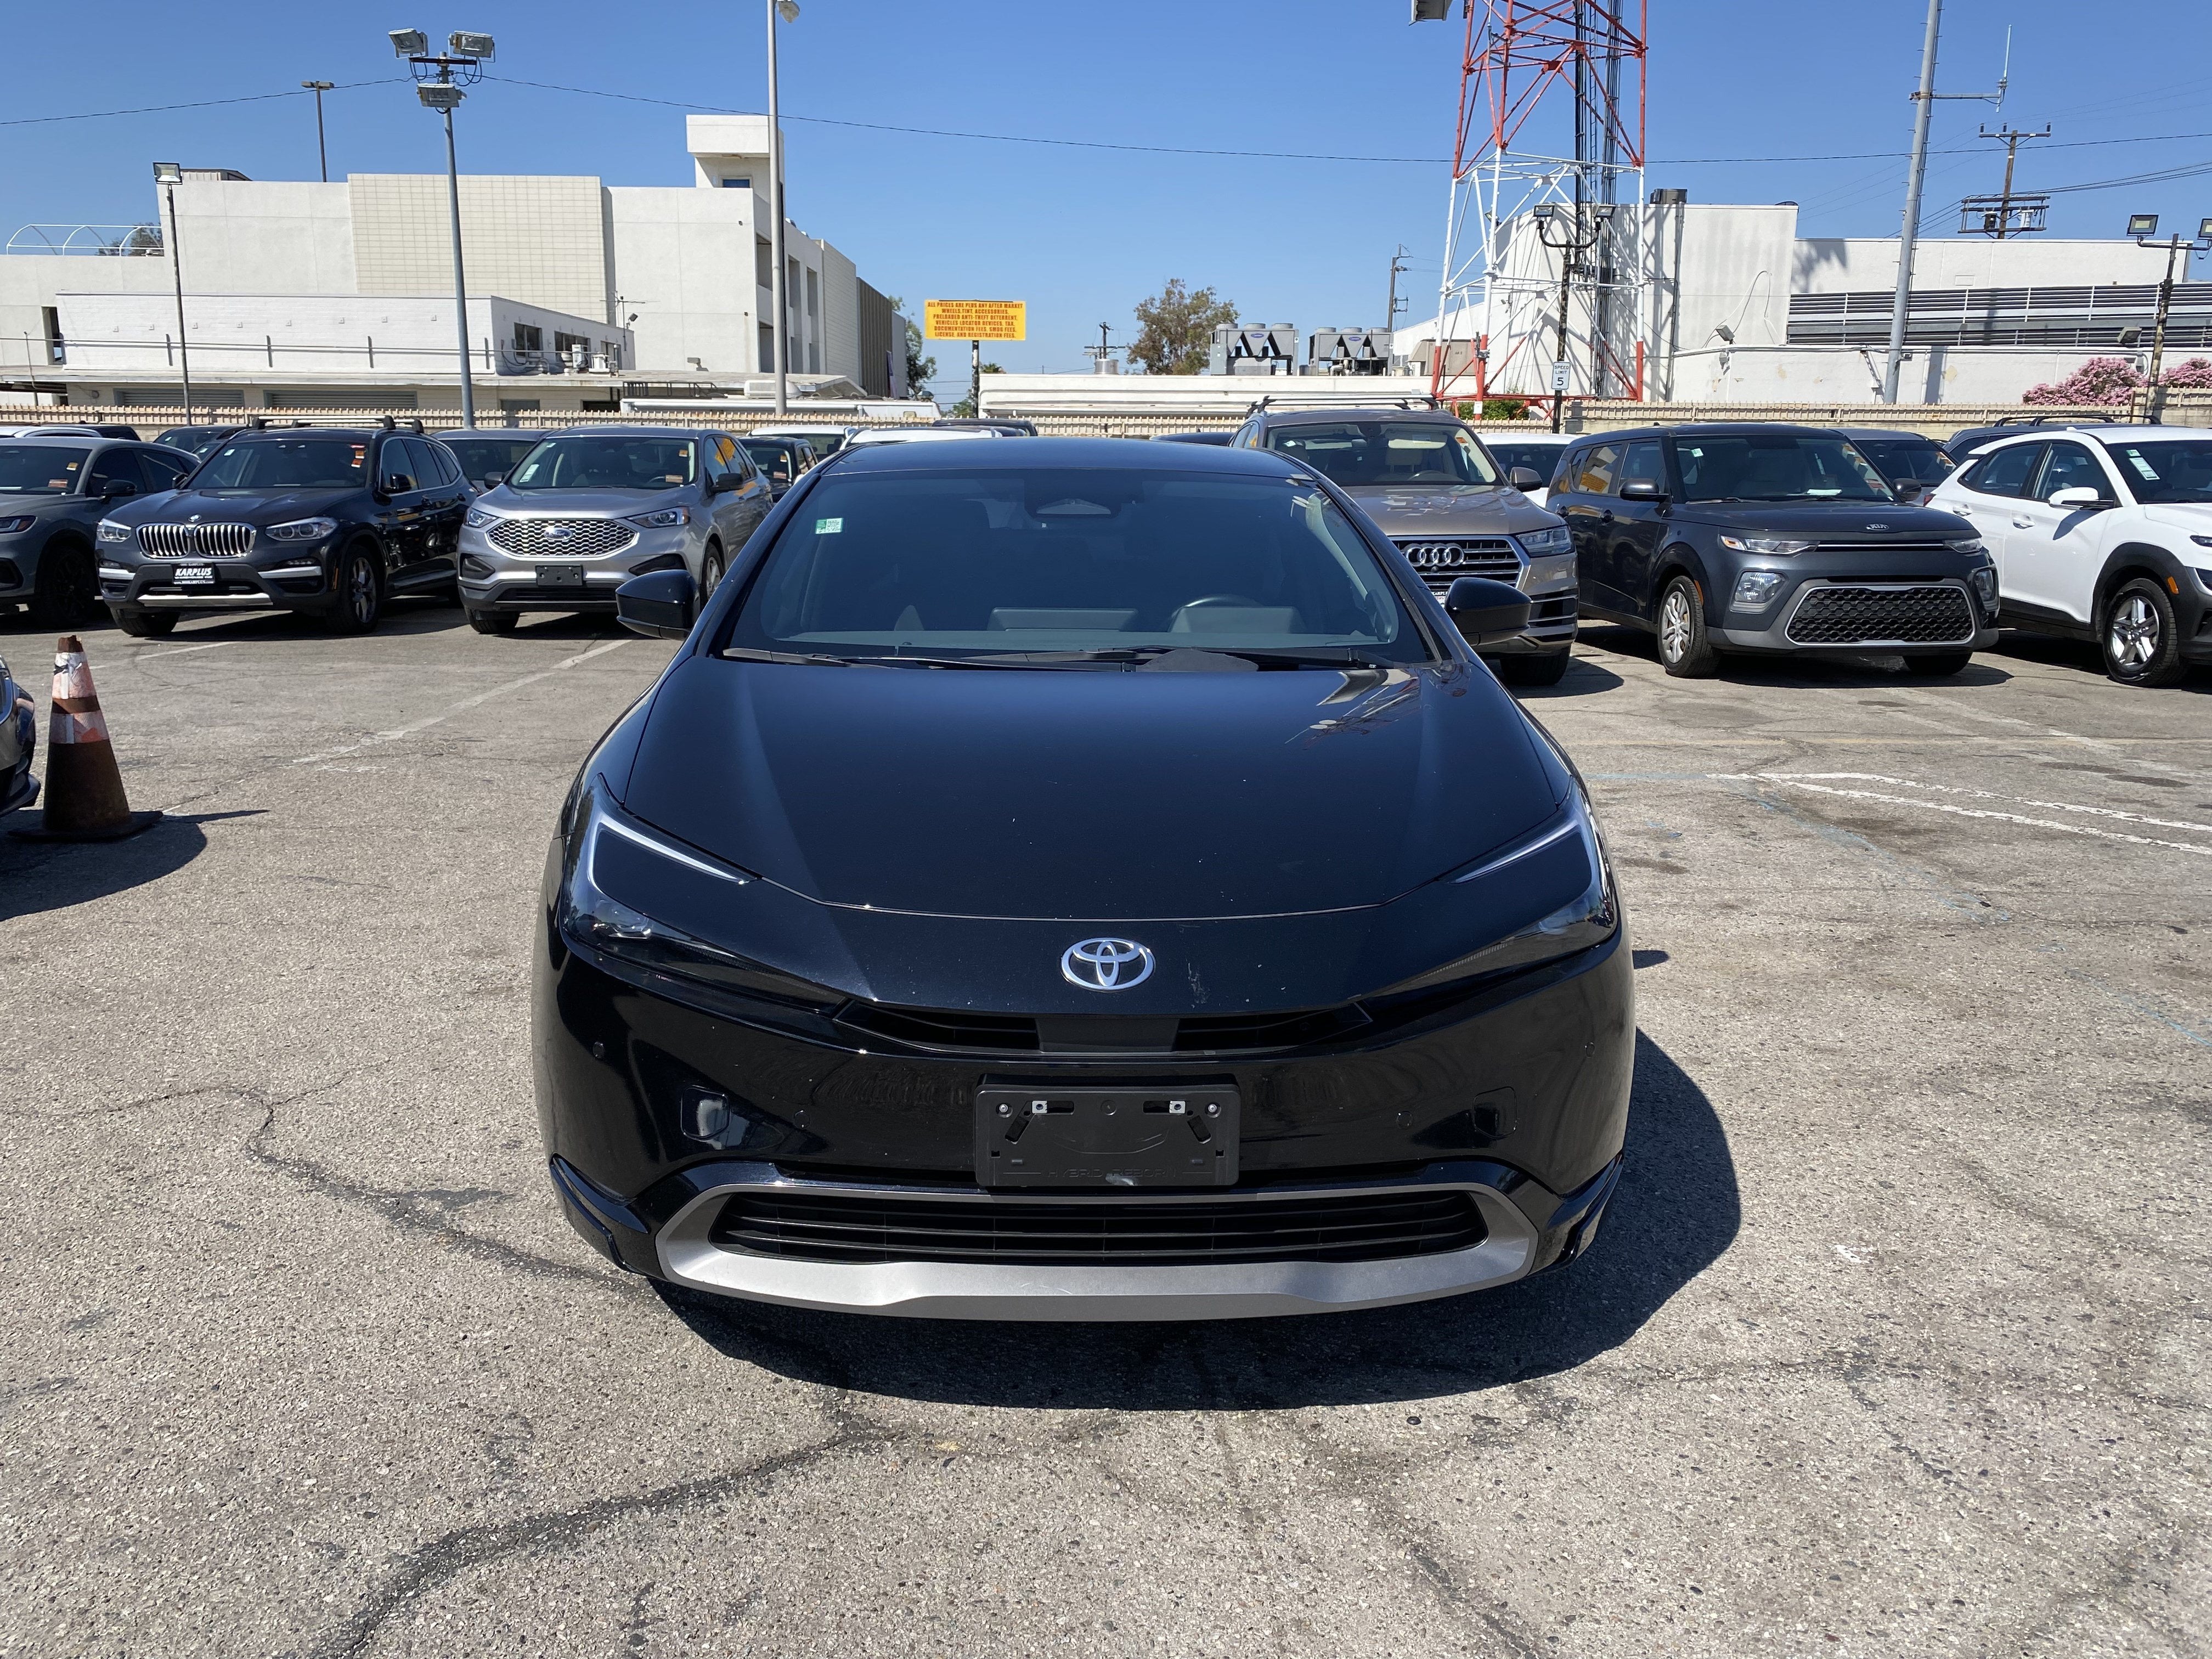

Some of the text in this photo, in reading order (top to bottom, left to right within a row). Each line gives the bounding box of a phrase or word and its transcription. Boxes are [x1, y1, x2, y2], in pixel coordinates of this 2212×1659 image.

[1557, 377, 1564, 386] 5
[175, 568, 212, 576] KARPLUS
[1047, 1169, 1177, 1178] HYBRID REBORN
